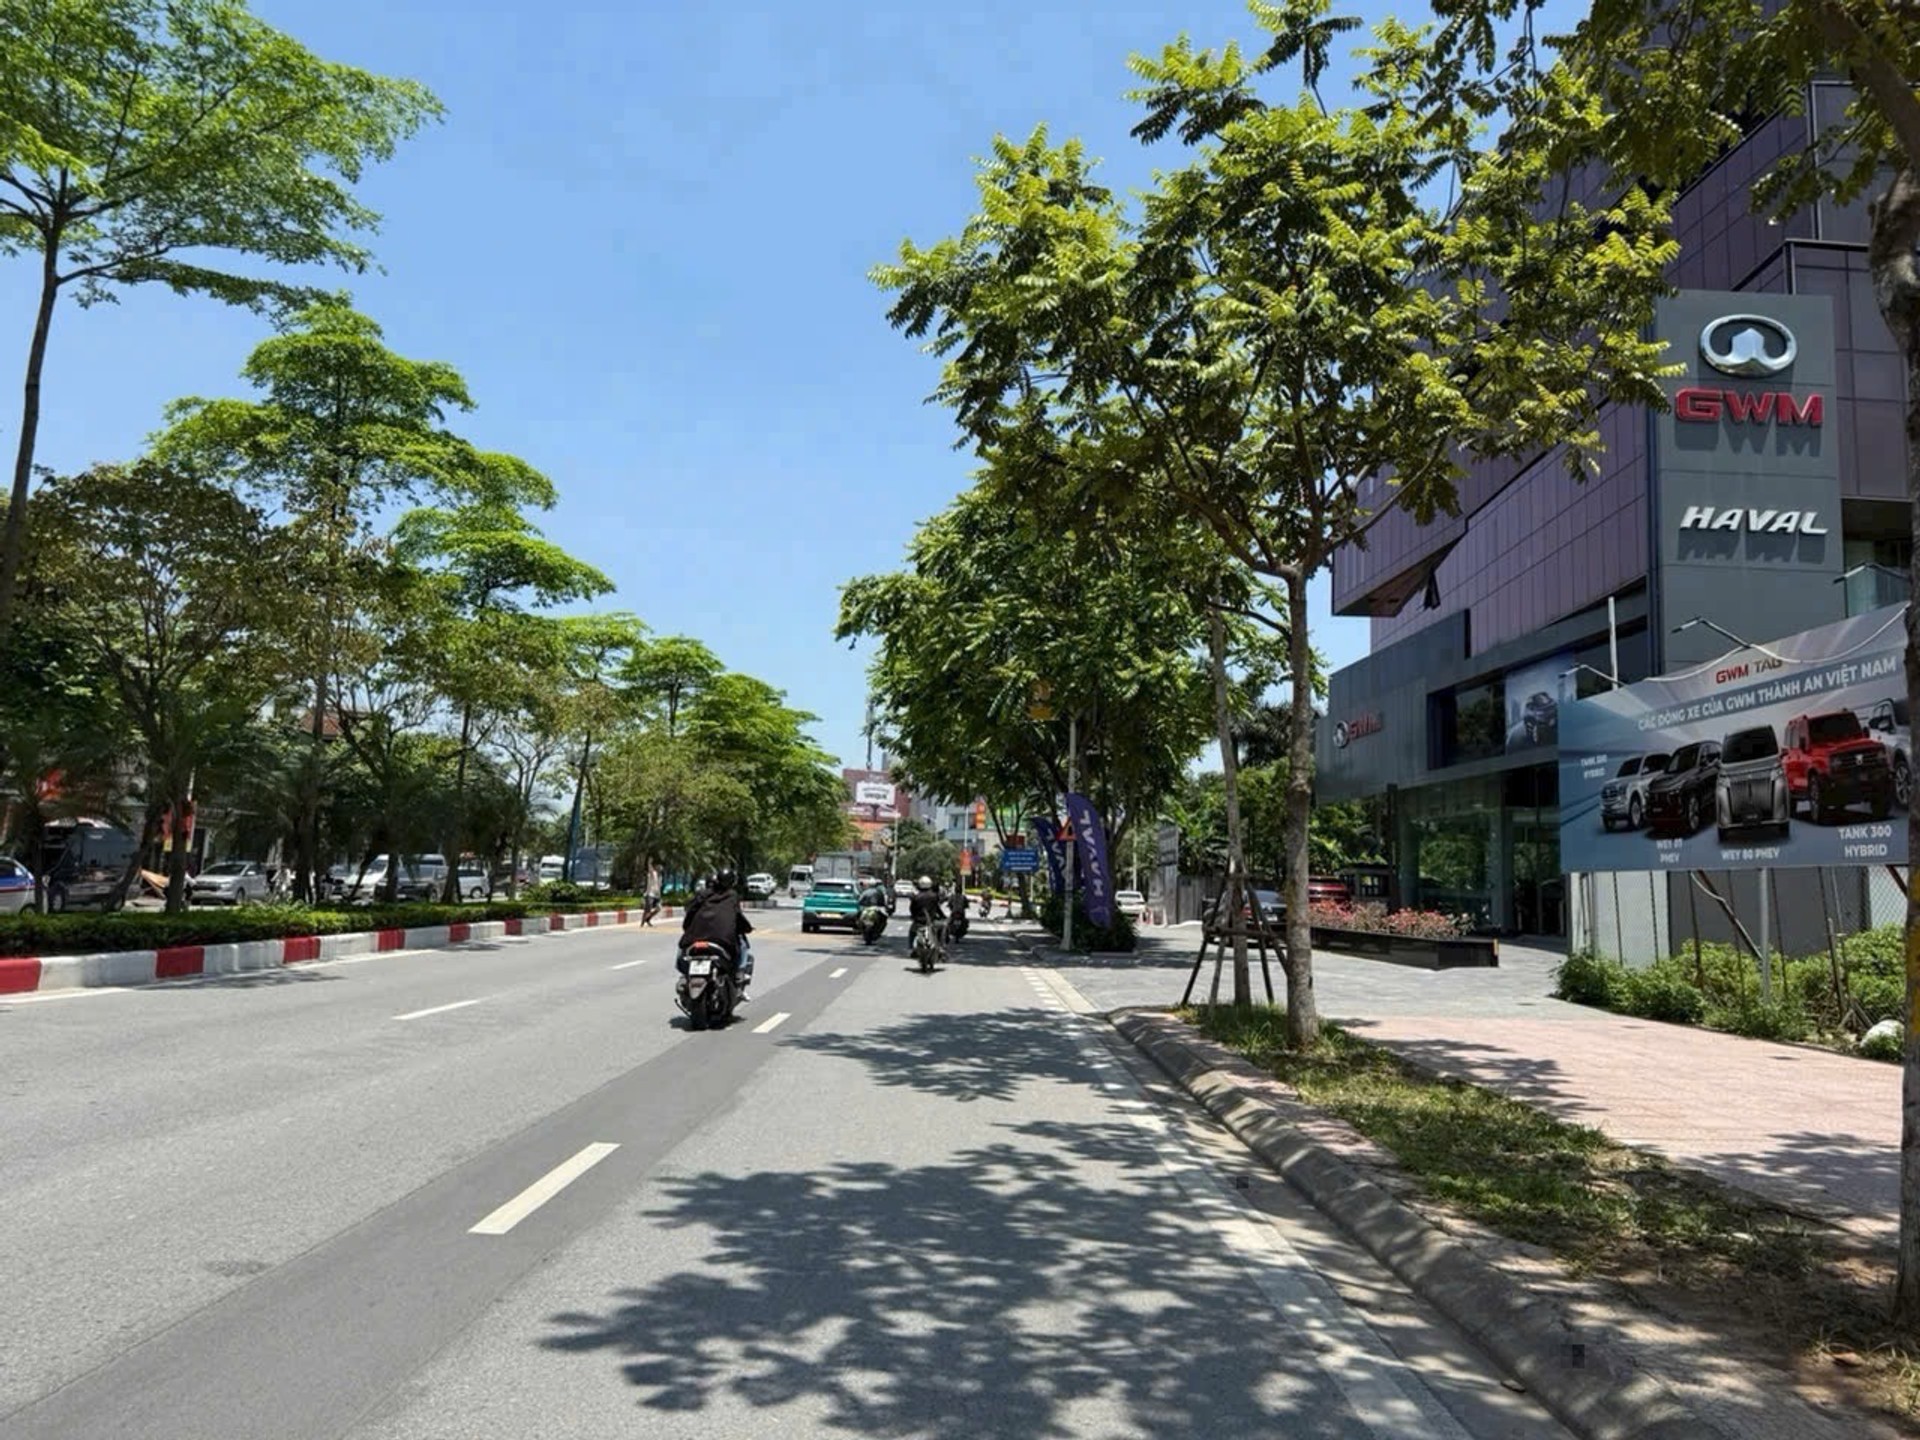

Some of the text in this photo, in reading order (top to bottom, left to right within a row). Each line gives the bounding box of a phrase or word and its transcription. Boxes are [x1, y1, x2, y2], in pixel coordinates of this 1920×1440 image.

[1675, 387, 1824, 425] GWM
[1680, 506, 1829, 534] HAVAL
[1716, 663, 1749, 684] GWM
[1687, 704, 1701, 720] XE
[1702, 696, 1725, 716] CỦA
[1726, 690, 1756, 711] GWM
[1757, 681, 1801, 704] THÀNH
[1803, 674, 1824, 693] AN
[1825, 663, 1858, 688] VIỆT
[1861, 655, 1898, 679] NAM
[1838, 825, 1893, 840] TANK 300
[1755, 846, 1781, 859] PHEV
[1844, 844, 1888, 858] HYBRID
